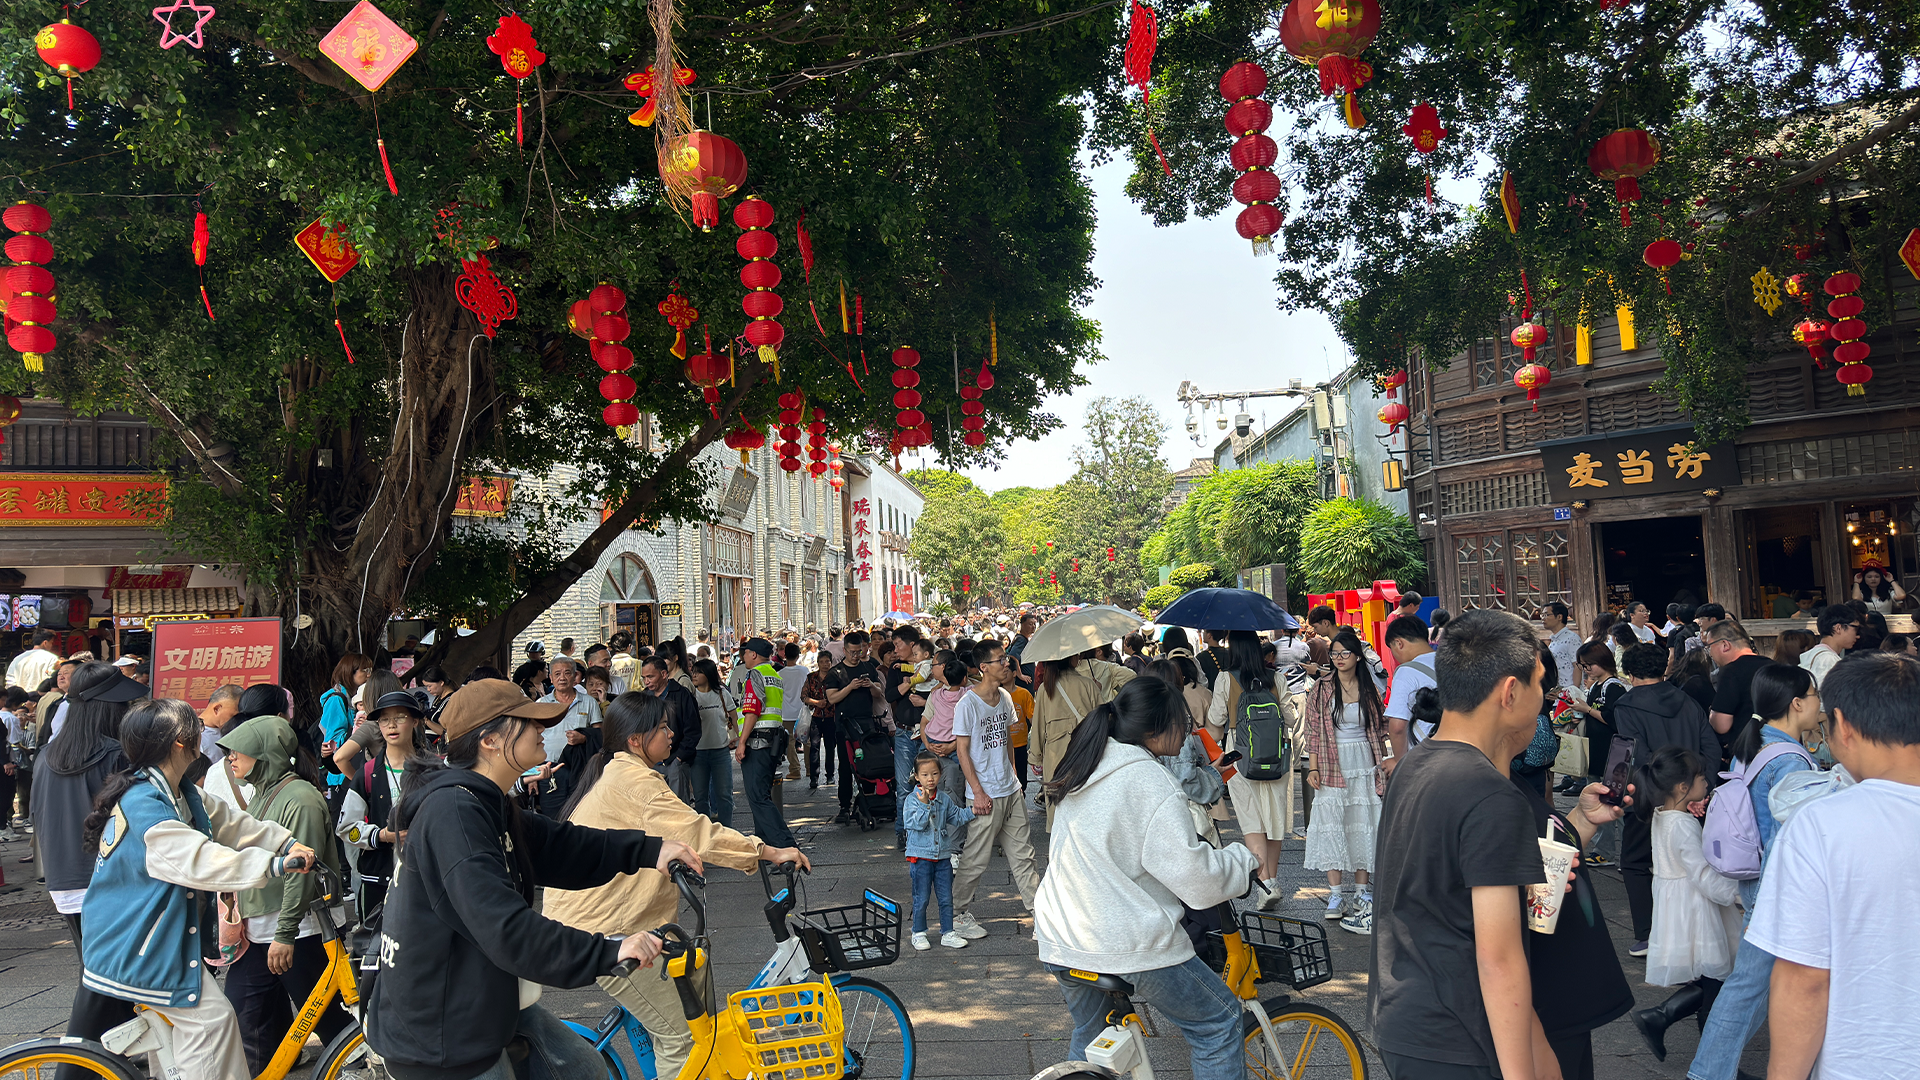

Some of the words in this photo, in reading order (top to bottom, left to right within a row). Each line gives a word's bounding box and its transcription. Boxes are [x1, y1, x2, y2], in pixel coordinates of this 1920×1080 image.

[351, 27, 387, 62] 福
[510, 47, 529, 72] 福
[1419, 129, 1434, 148] 福
[320, 230, 345, 260] 福
[1566, 441, 1711, 488] 麦当劳
[160, 645, 273, 671] 文明旅游
[981, 716, 991, 727] HIS
[986, 722, 1005, 732] ABOUT
[984, 740, 998, 751] AND
[291, 997, 323, 1043] 美团单车
